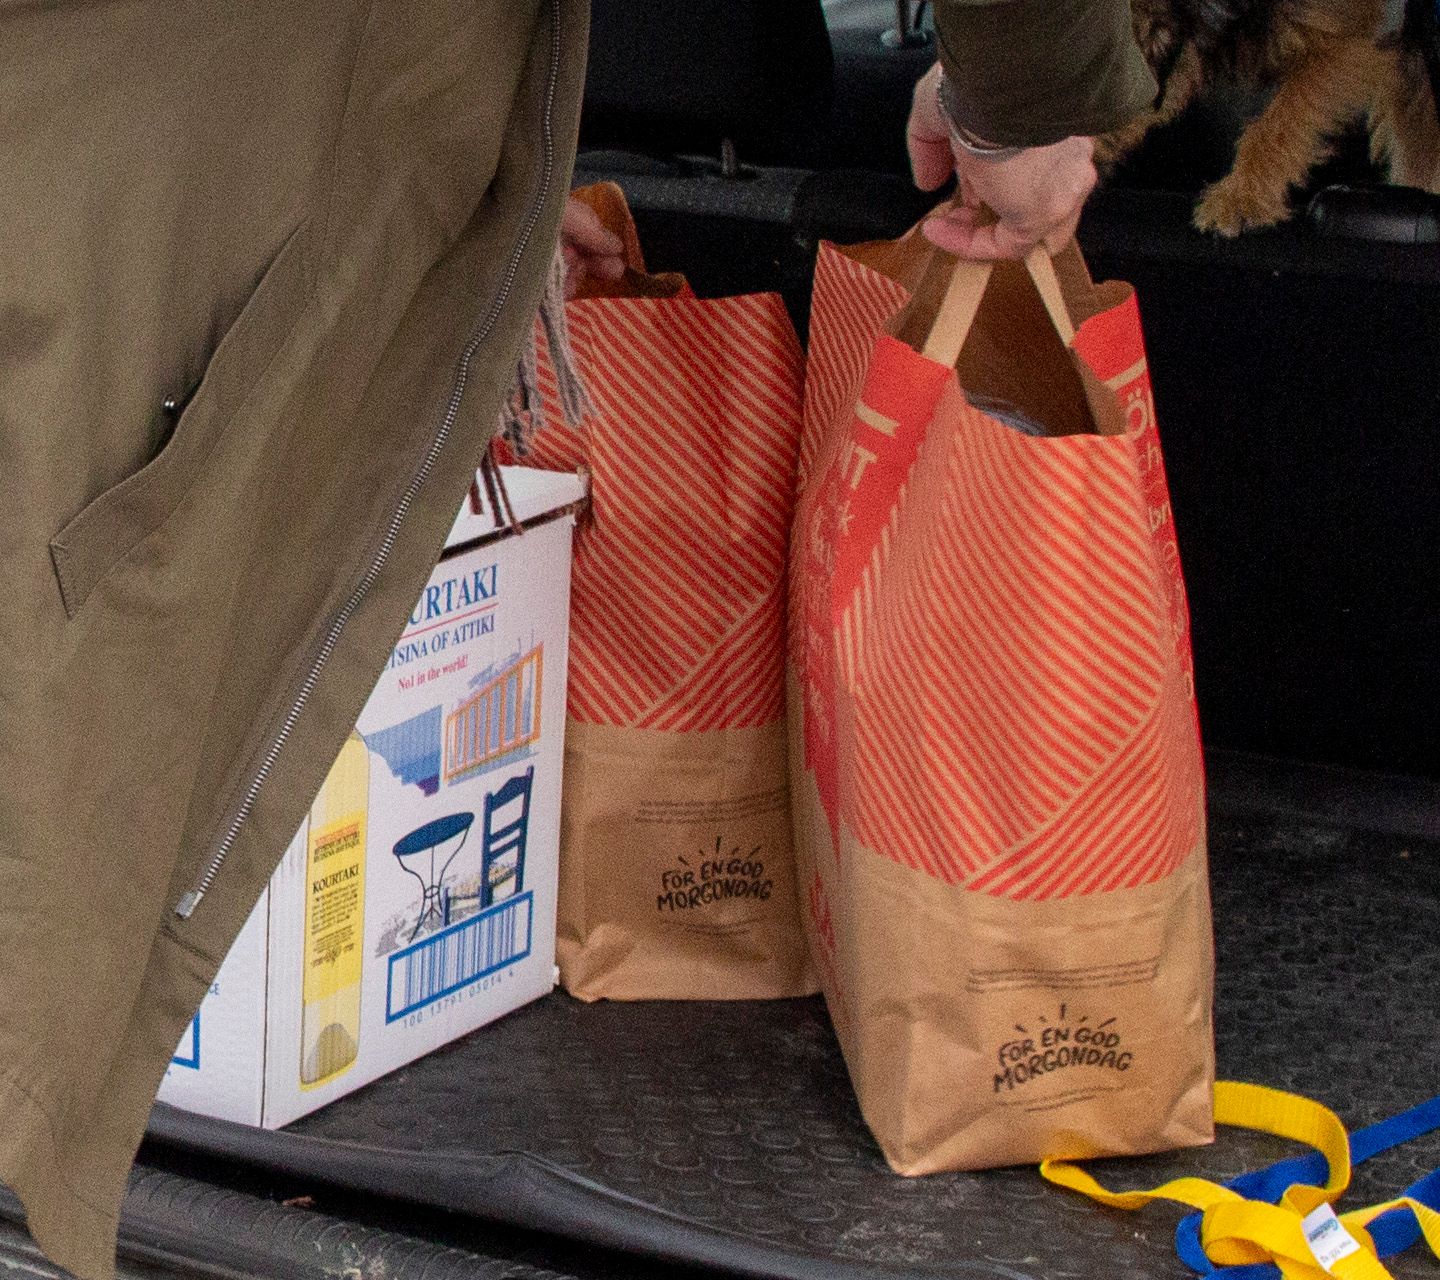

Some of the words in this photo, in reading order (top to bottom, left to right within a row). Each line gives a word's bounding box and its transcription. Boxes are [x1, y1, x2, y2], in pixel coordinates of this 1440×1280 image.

[409, 563, 498, 625] URTAKI
[387, 637, 428, 669] TSINA
[431, 630, 450, 653] OF
[452, 613, 495, 646] ATTIKI
[312, 863, 360, 894] KOURTAKI
[700, 860, 724, 880] EN
[727, 858, 764, 878] GOD
[656, 879, 775, 911] MORGONDAG
[1041, 1027, 1070, 1048] EN
[1074, 1027, 1120, 1048] GOD
[993, 1046, 1134, 1093] MORGONDAG
